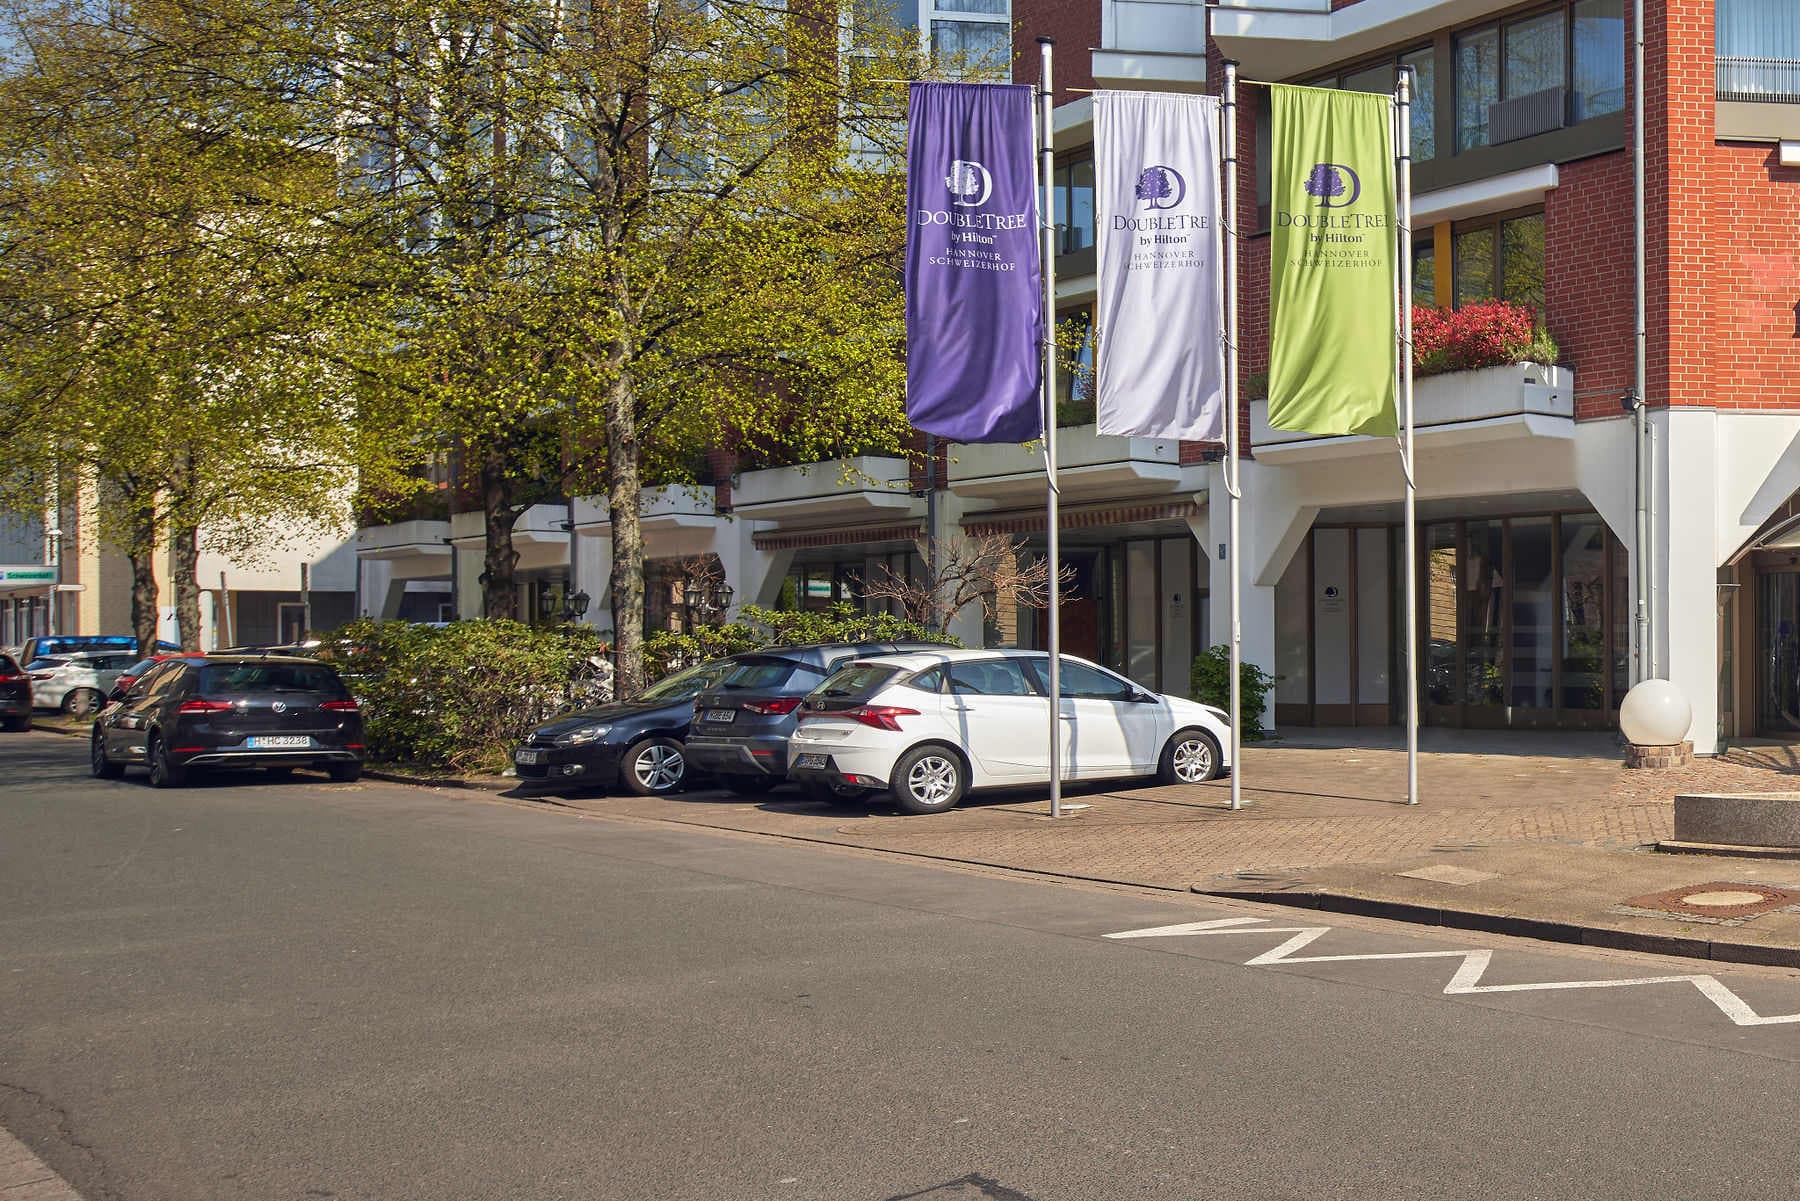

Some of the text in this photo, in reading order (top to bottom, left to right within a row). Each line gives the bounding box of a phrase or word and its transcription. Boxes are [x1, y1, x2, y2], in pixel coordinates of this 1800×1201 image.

[1113, 214, 1209, 231] DOUBLETRE
[951, 231, 961, 243] by
[1140, 235, 1152, 248] by
[1310, 233, 1322, 244] by
[946, 247, 1001, 261] HANNOVER
[1134, 250, 1195, 261] HANNOVER
[929, 256, 1016, 272] SCHWEIZERHOF
